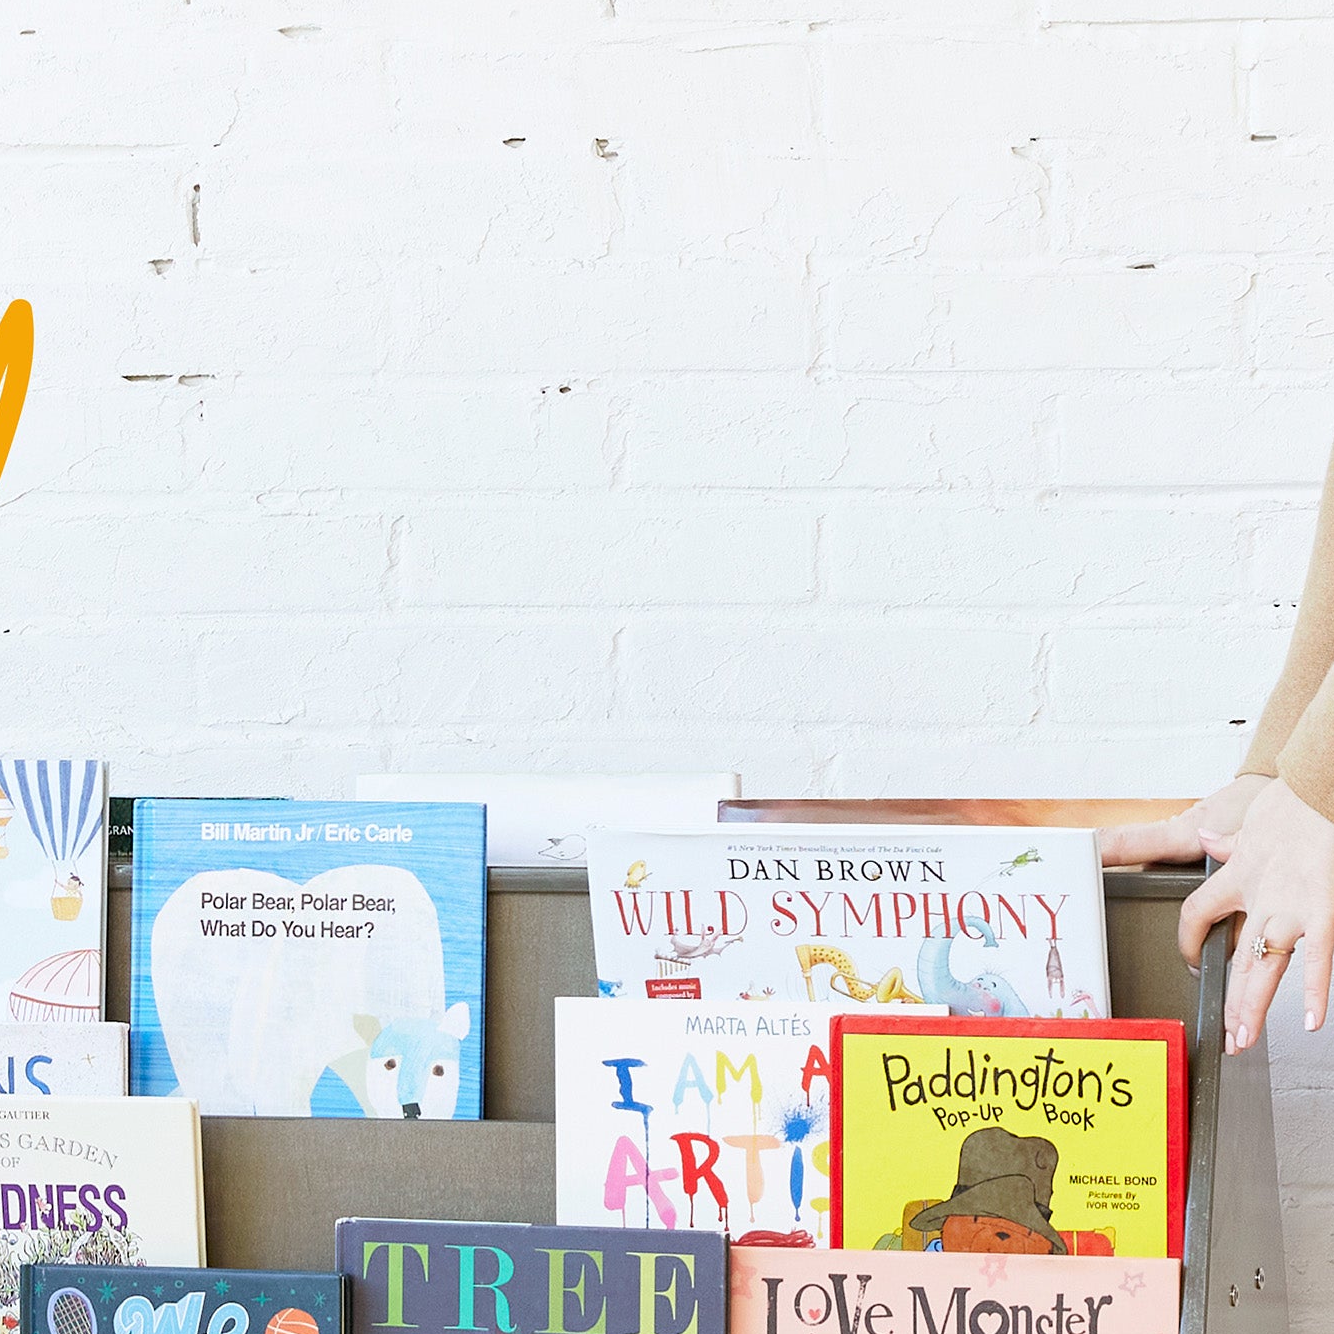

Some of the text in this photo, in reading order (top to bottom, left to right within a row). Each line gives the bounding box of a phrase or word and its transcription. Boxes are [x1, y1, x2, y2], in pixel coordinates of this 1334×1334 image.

[201, 823, 230, 842] Bill
[233, 823, 291, 843] Martin
[364, 824, 413, 844] Carle
[727, 858, 947, 883] DAN BROWN
[201, 892, 396, 914] Polar Bear, Polar Bear,
[610, 889, 1071, 942] WILD SYMPHONY
[200, 919, 375, 940] What Do You Hear?
[685, 1012, 812, 1037] MARTA ALTÉS
[602, 1058, 654, 1114] I
[672, 1050, 763, 1109] AM
[882, 1047, 1134, 1111] Paddington's
[932, 1102, 1096, 1131] Pop-Up Book
[0, 1156, 21, 1169] OF
[18, 1133, 119, 1170] GARDEN
[1124, 1175, 1158, 1187] BOND
[1086, 1201, 1141, 1211] IVOR WOOD
[1088, 1191, 1137, 1202] Pictures By
